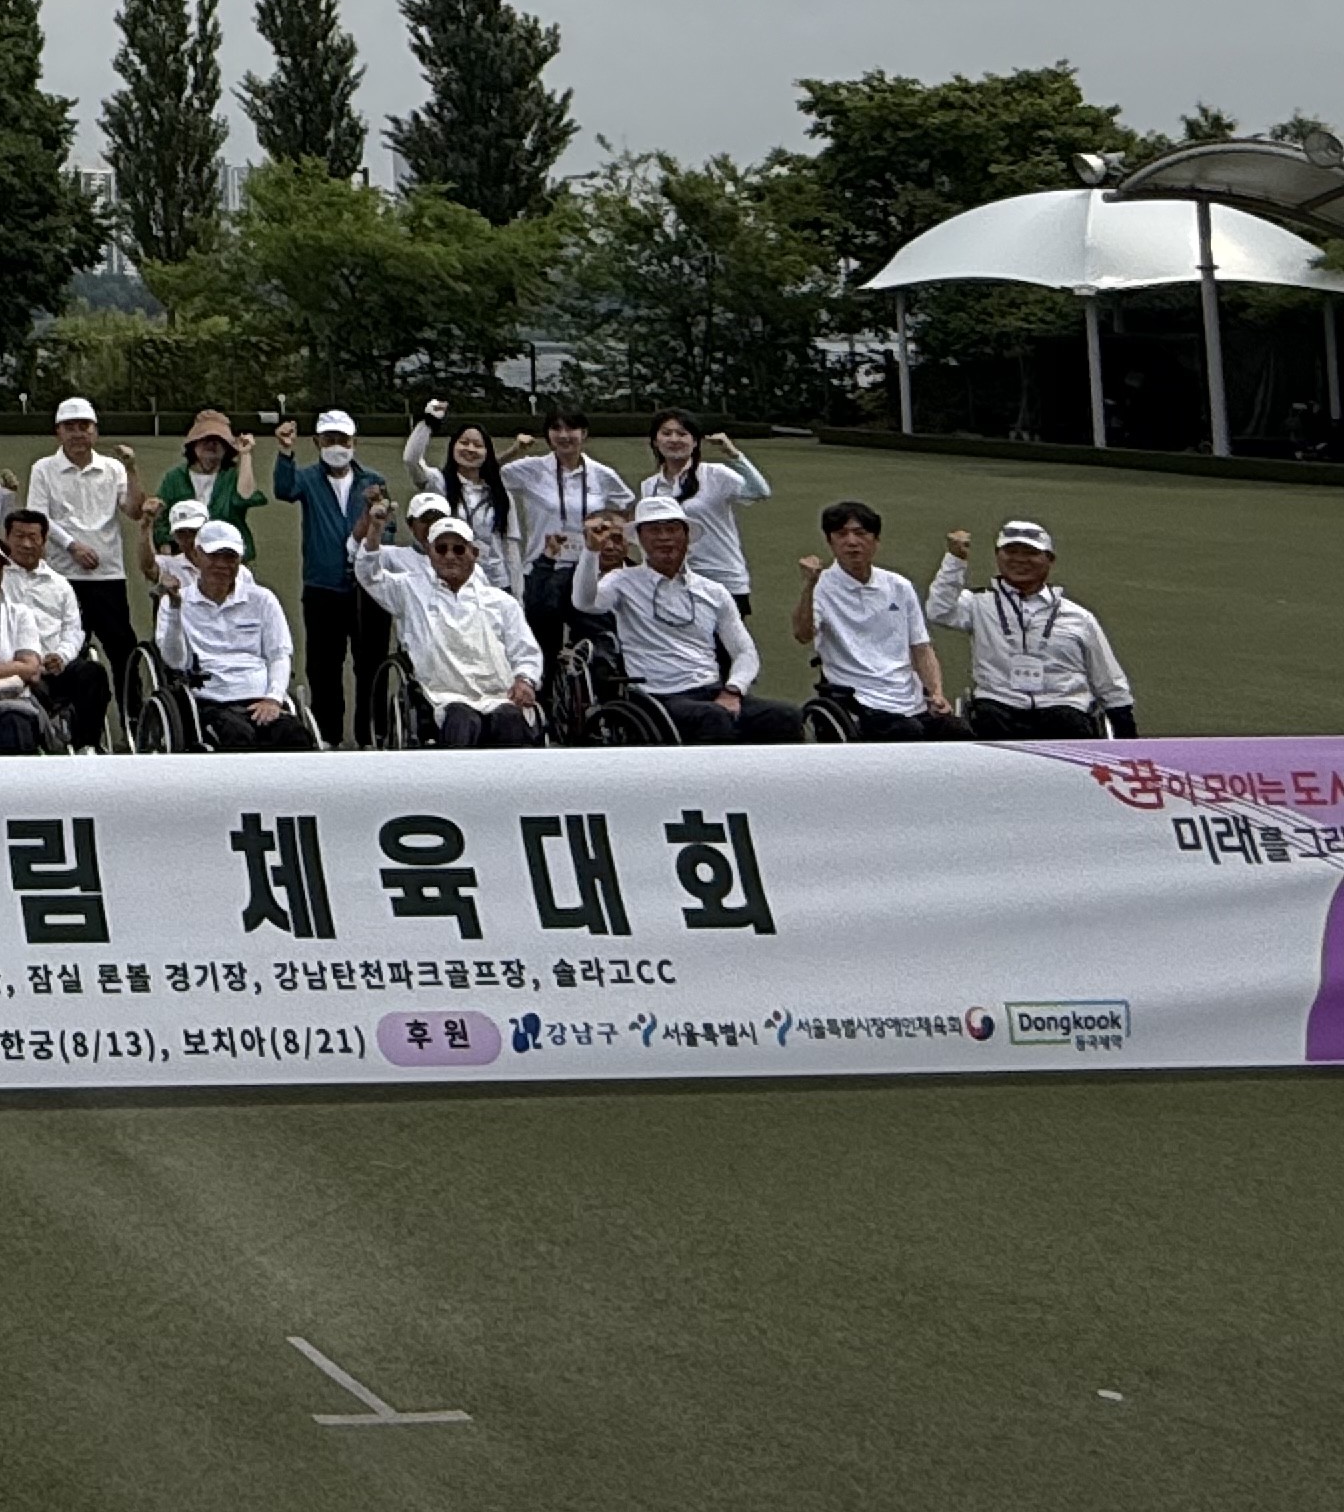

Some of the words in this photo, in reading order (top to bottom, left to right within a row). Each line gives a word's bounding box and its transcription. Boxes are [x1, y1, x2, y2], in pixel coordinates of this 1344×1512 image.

[1202, 771, 1288, 806] 모이는
[1172, 814, 1292, 864] 미래를
[230, 810, 777, 939] 체육대회
[27, 964, 83, 994] 잠실
[98, 964, 151, 993] 론볼
[165, 961, 261, 995] 경기장,
[274, 959, 540, 991] 강남탄천파크골프장,
[546, 1022, 619, 1046] 강남구
[662, 1021, 758, 1048] 서울특별시
[796, 1014, 963, 1040] 서울특별시장애인체육회
[1018, 1010, 1122, 1035] Dongkook
[0, 1029, 169, 1063] 한궁(8/13),
[183, 1026, 365, 1060] 보치아(8/21)
